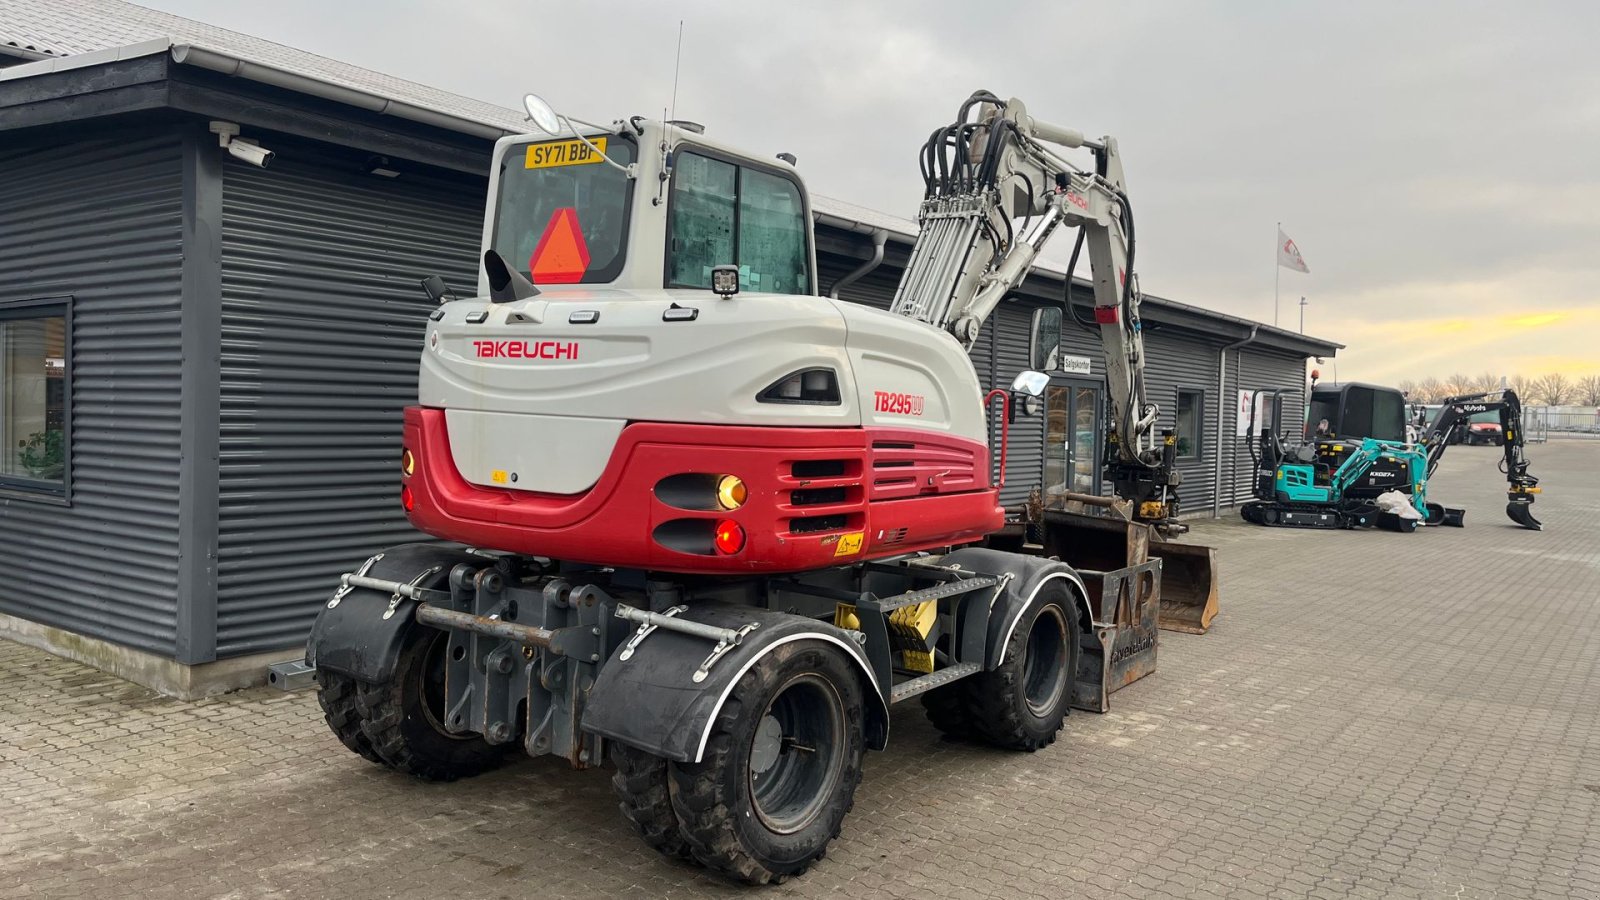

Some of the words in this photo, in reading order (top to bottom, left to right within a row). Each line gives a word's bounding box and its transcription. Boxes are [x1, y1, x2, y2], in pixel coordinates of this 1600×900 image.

[534, 144, 566, 164] SY71
[569, 142, 598, 161] BBF
[874, 391, 925, 416] TB295W
